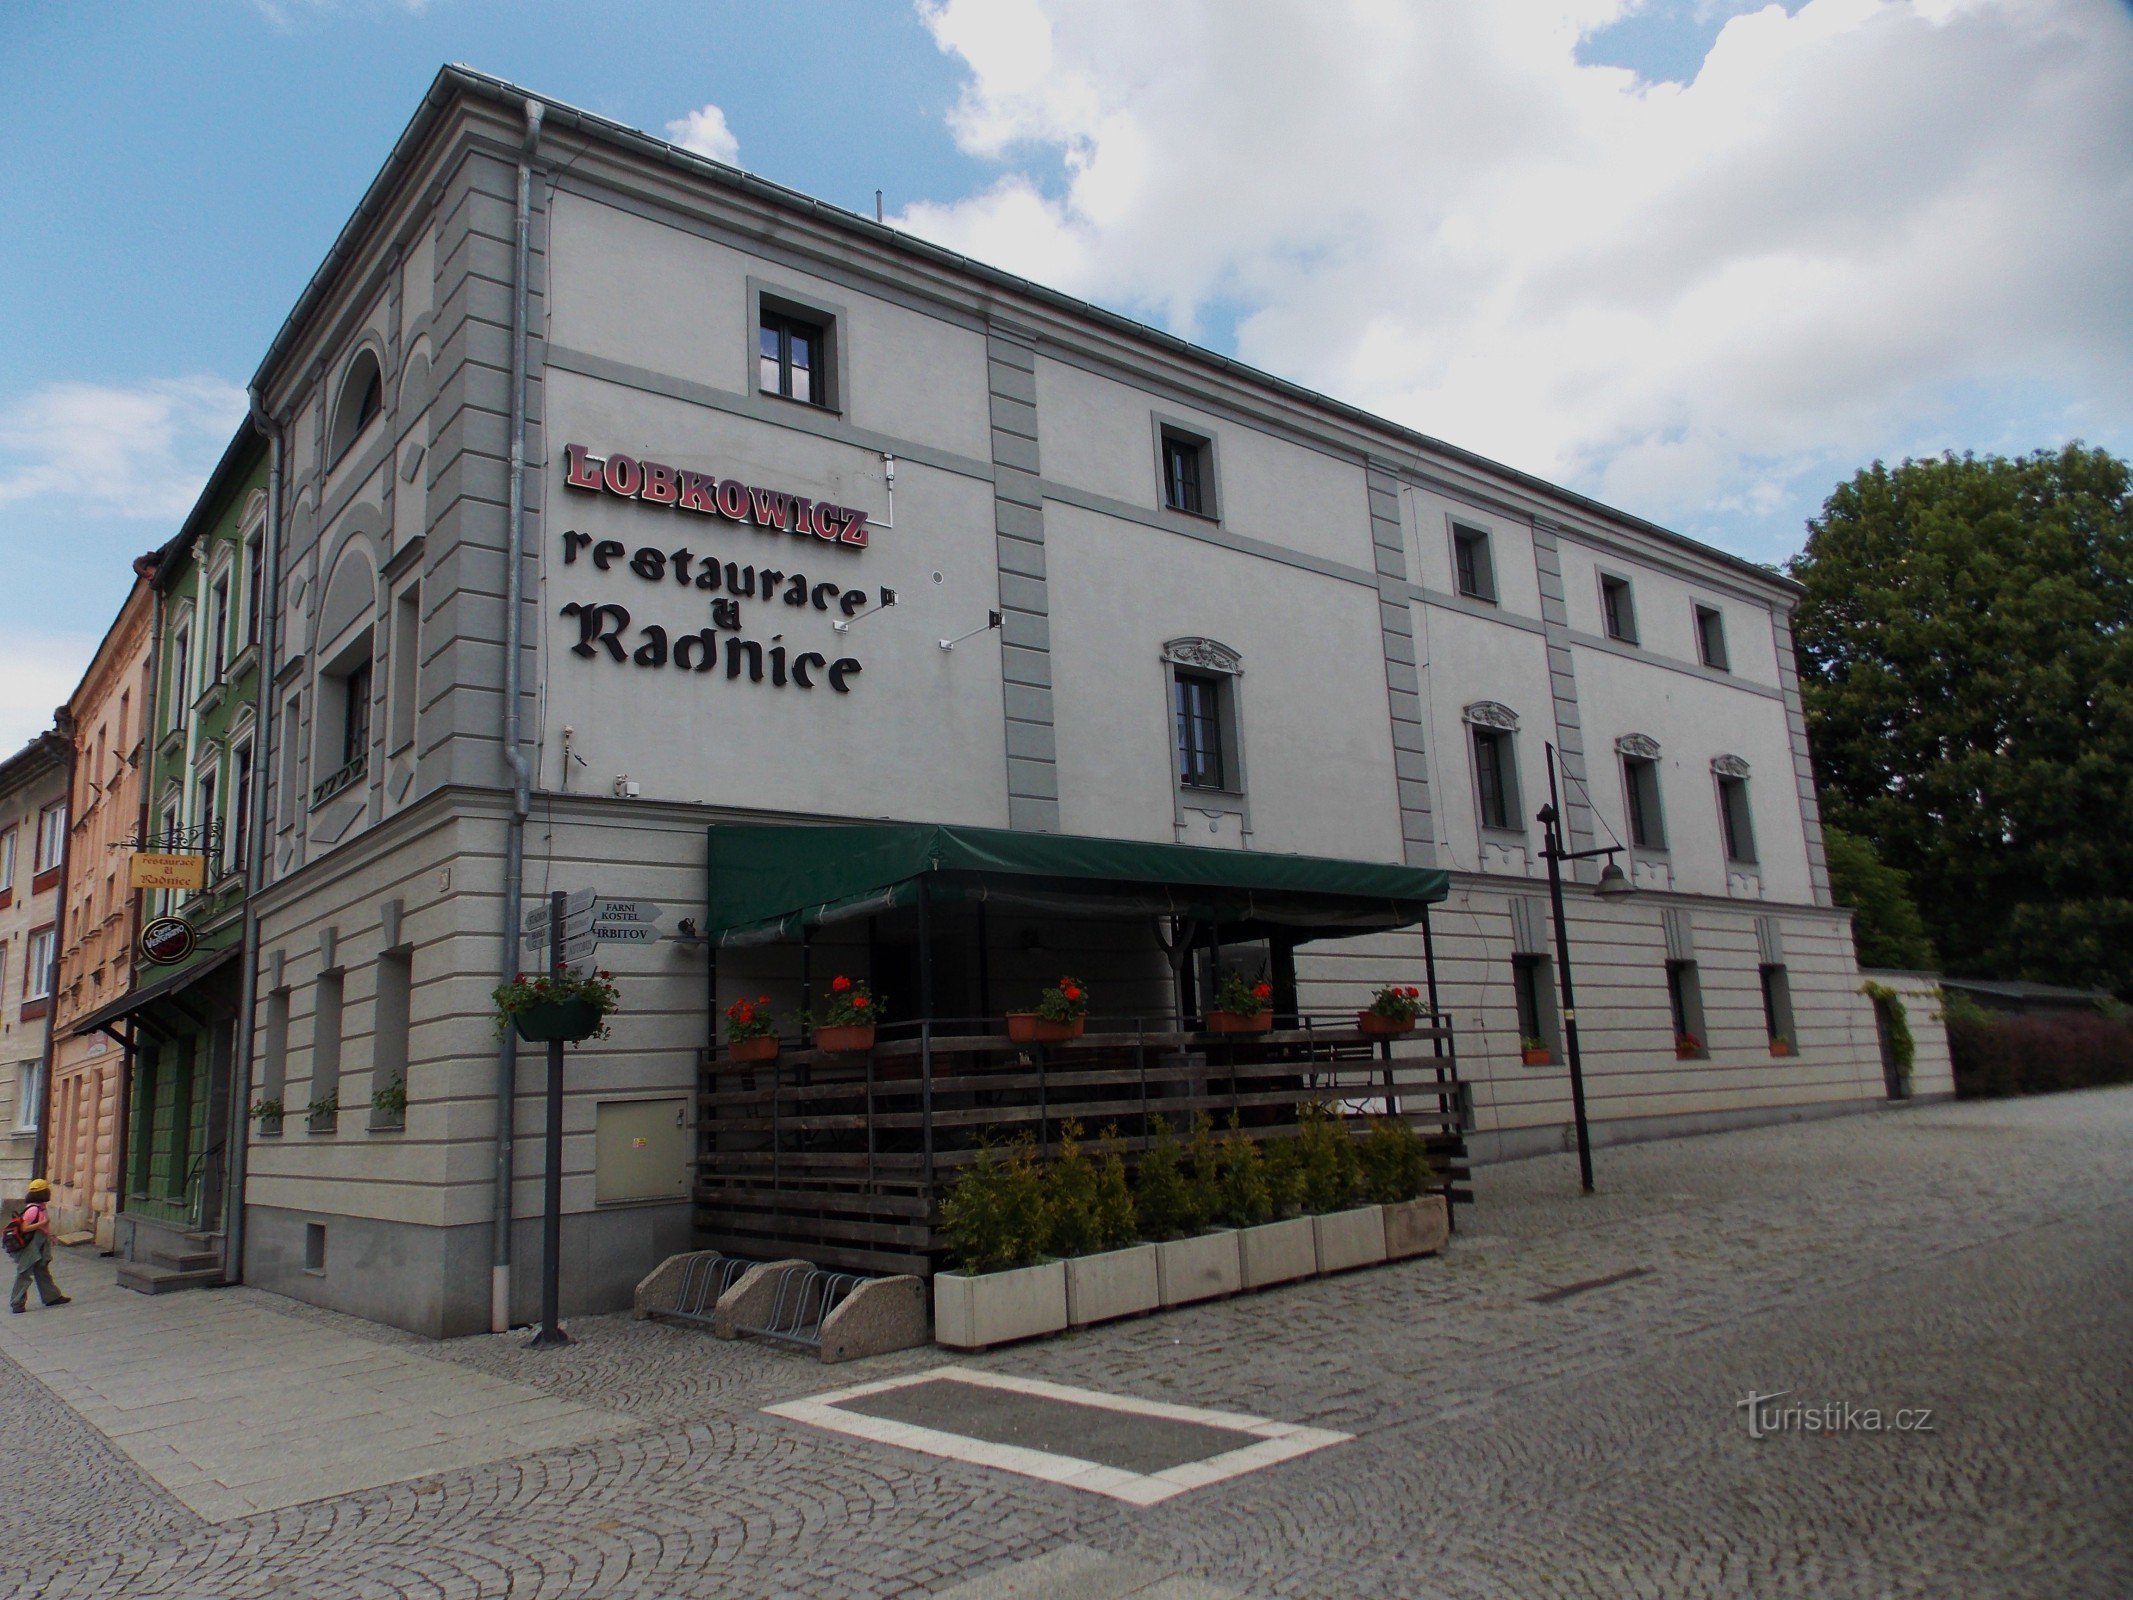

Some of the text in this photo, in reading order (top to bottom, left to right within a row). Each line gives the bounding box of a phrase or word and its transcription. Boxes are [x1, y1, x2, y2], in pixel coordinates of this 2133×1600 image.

[564, 443, 869, 548] LOBKOWICZ
[563, 530, 868, 615] restaurace
[560, 602, 862, 692] Radnice
[143, 856, 195, 867] restaurace
[141, 874, 191, 886] Radnice
[606, 903, 636, 912] FARNÍ
[601, 912, 640, 921] KOSTEL
[592, 926, 648, 940] HŘBITOV
